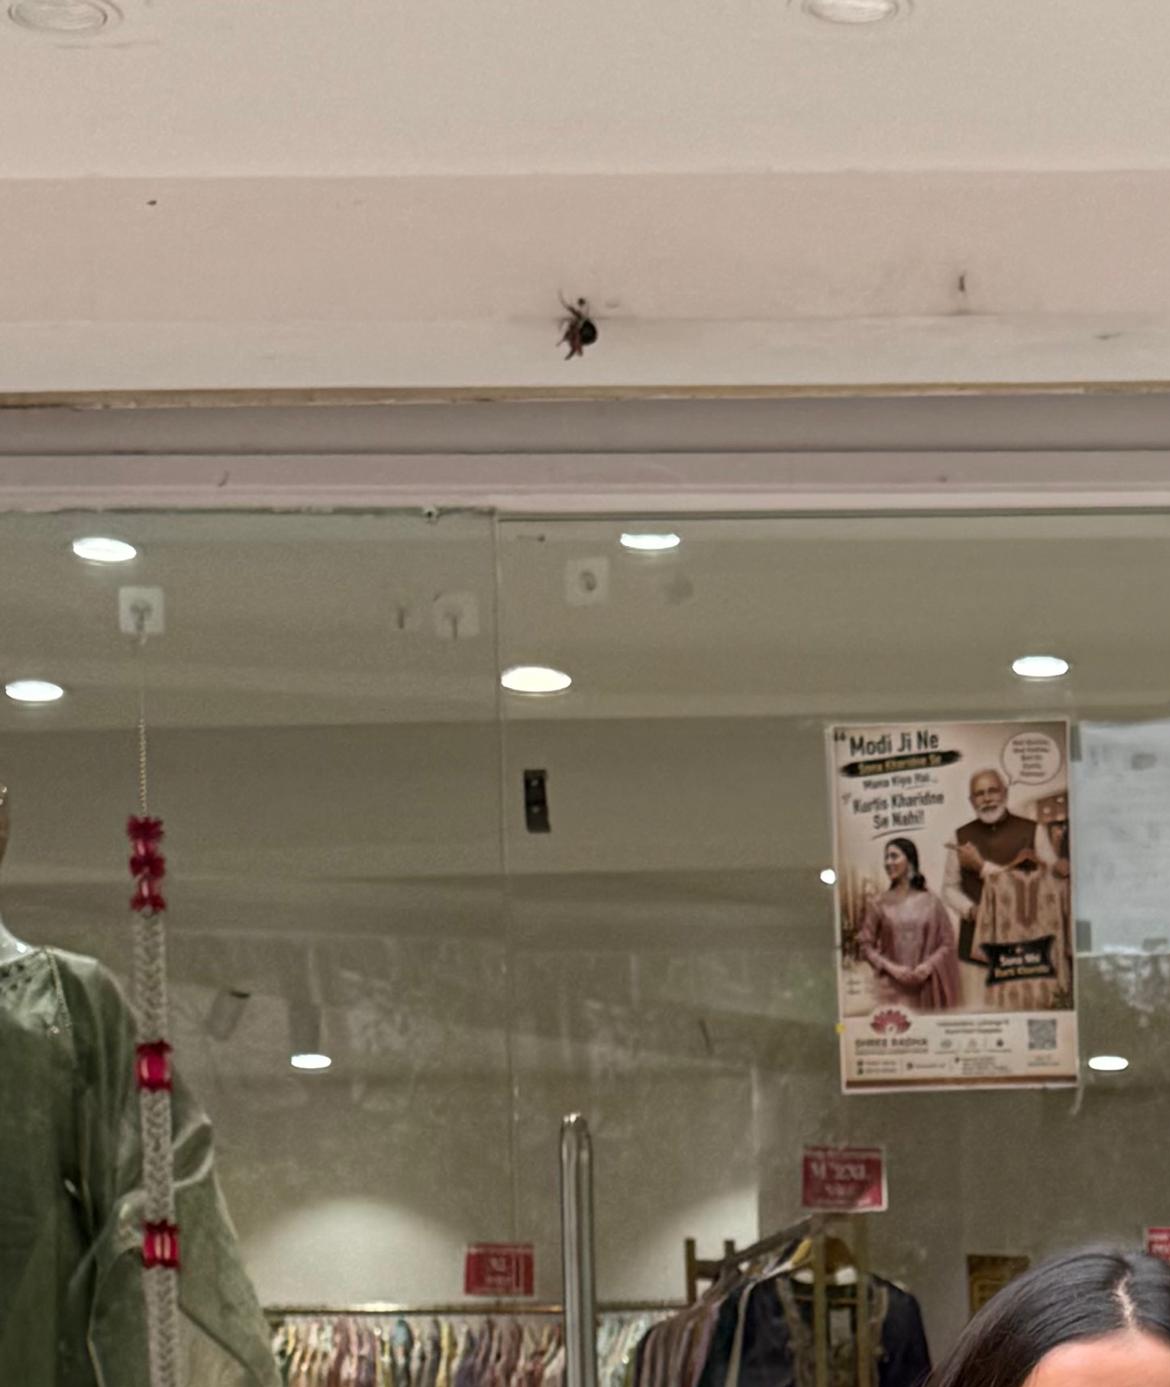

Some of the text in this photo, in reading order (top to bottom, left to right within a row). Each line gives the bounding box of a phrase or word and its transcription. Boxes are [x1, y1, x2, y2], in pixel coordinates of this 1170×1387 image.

[849, 730, 939, 756] Modi Ji Ne
